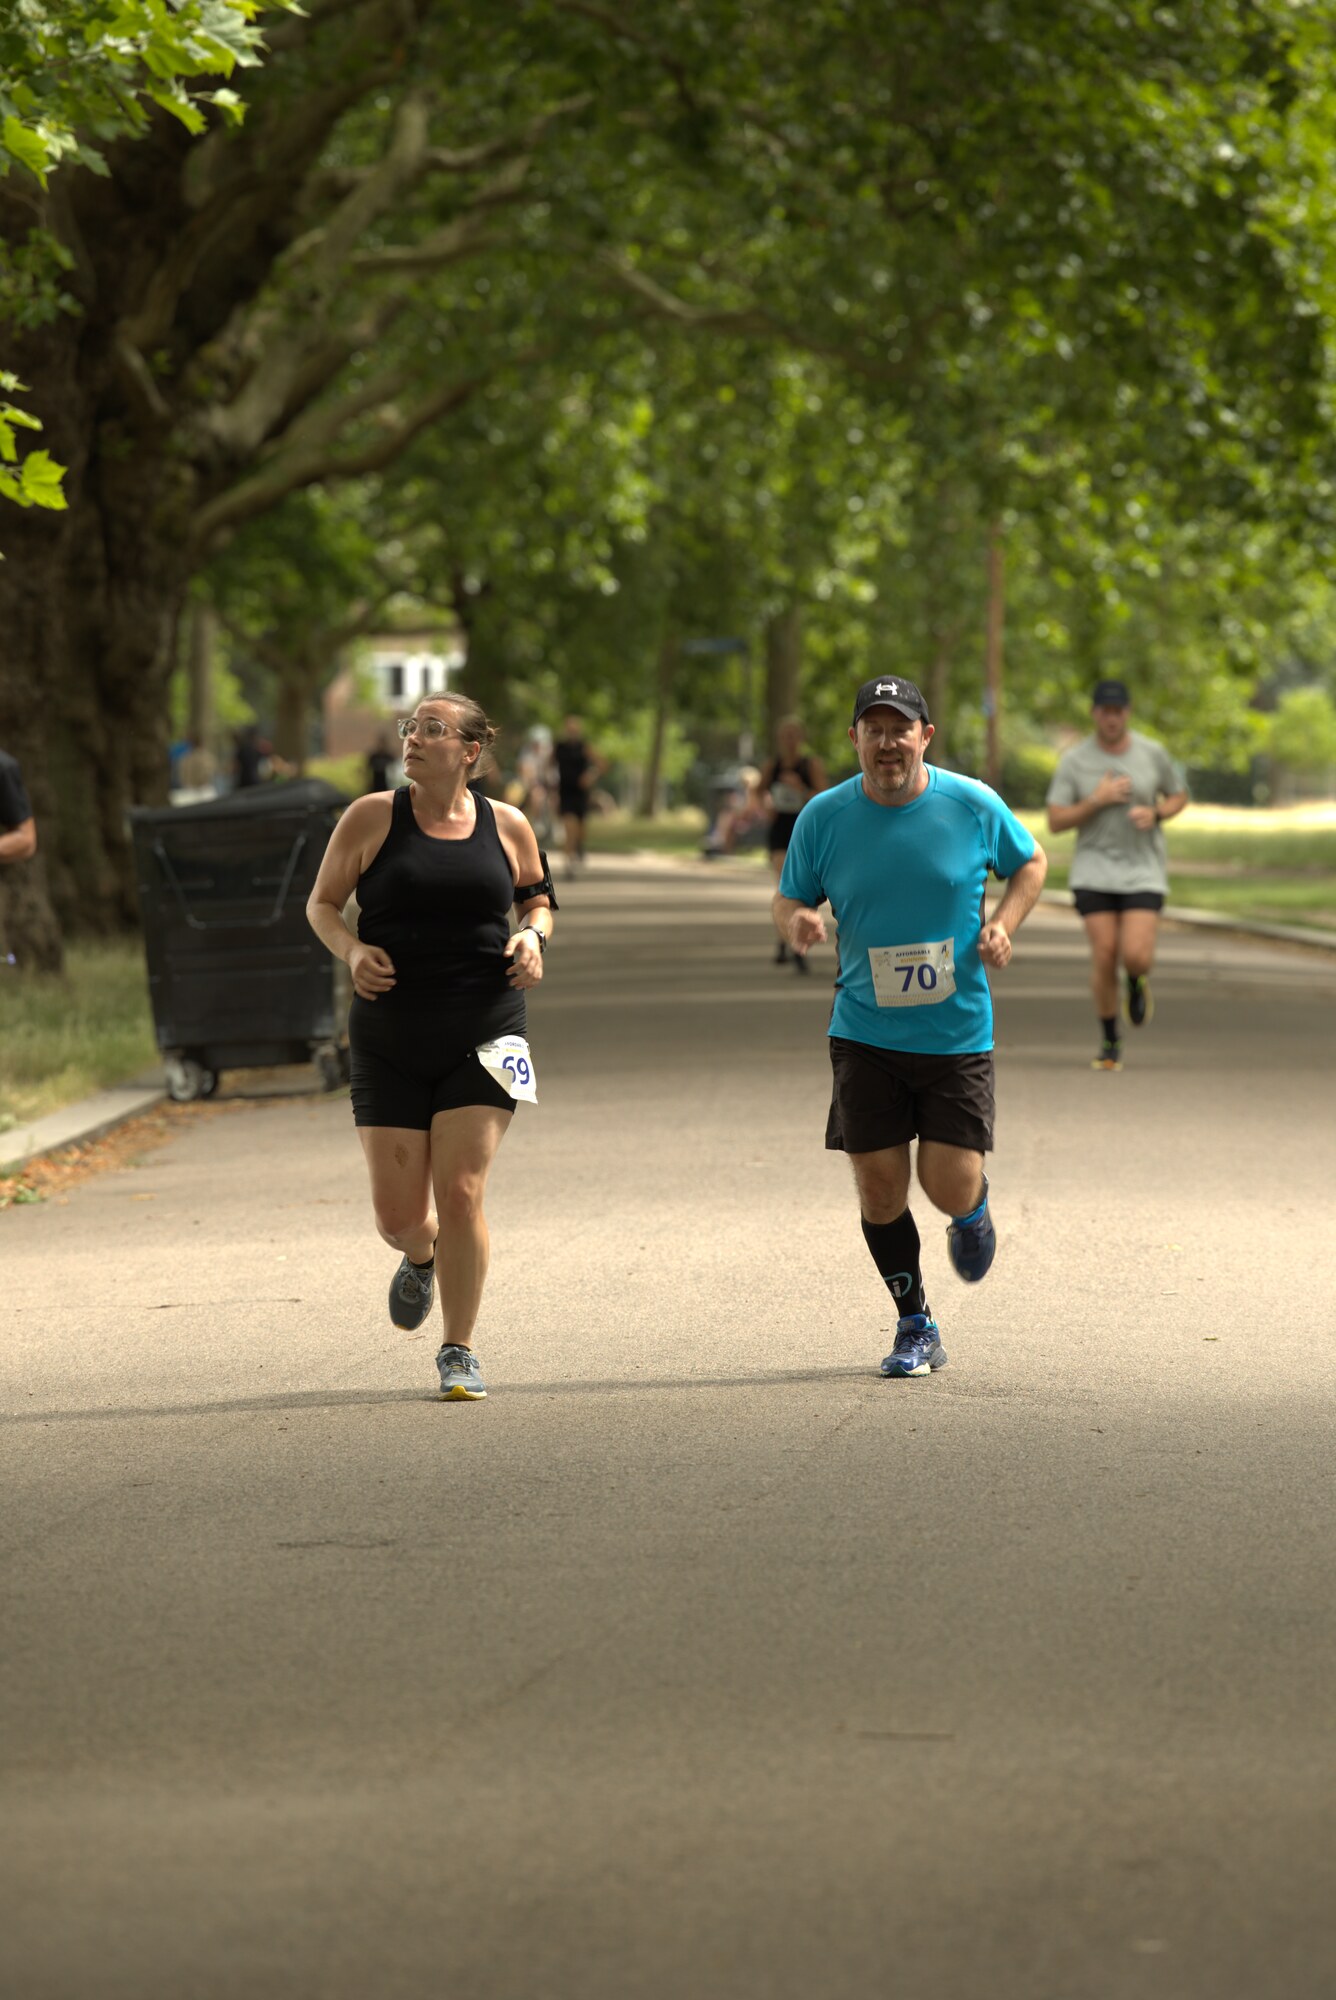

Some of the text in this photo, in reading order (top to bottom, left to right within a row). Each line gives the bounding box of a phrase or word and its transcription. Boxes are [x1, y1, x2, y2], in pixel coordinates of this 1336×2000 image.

[895, 949, 931, 957] AFFORDABLE
[895, 964, 937, 992] 70
[502, 1056, 530, 1085] 69
